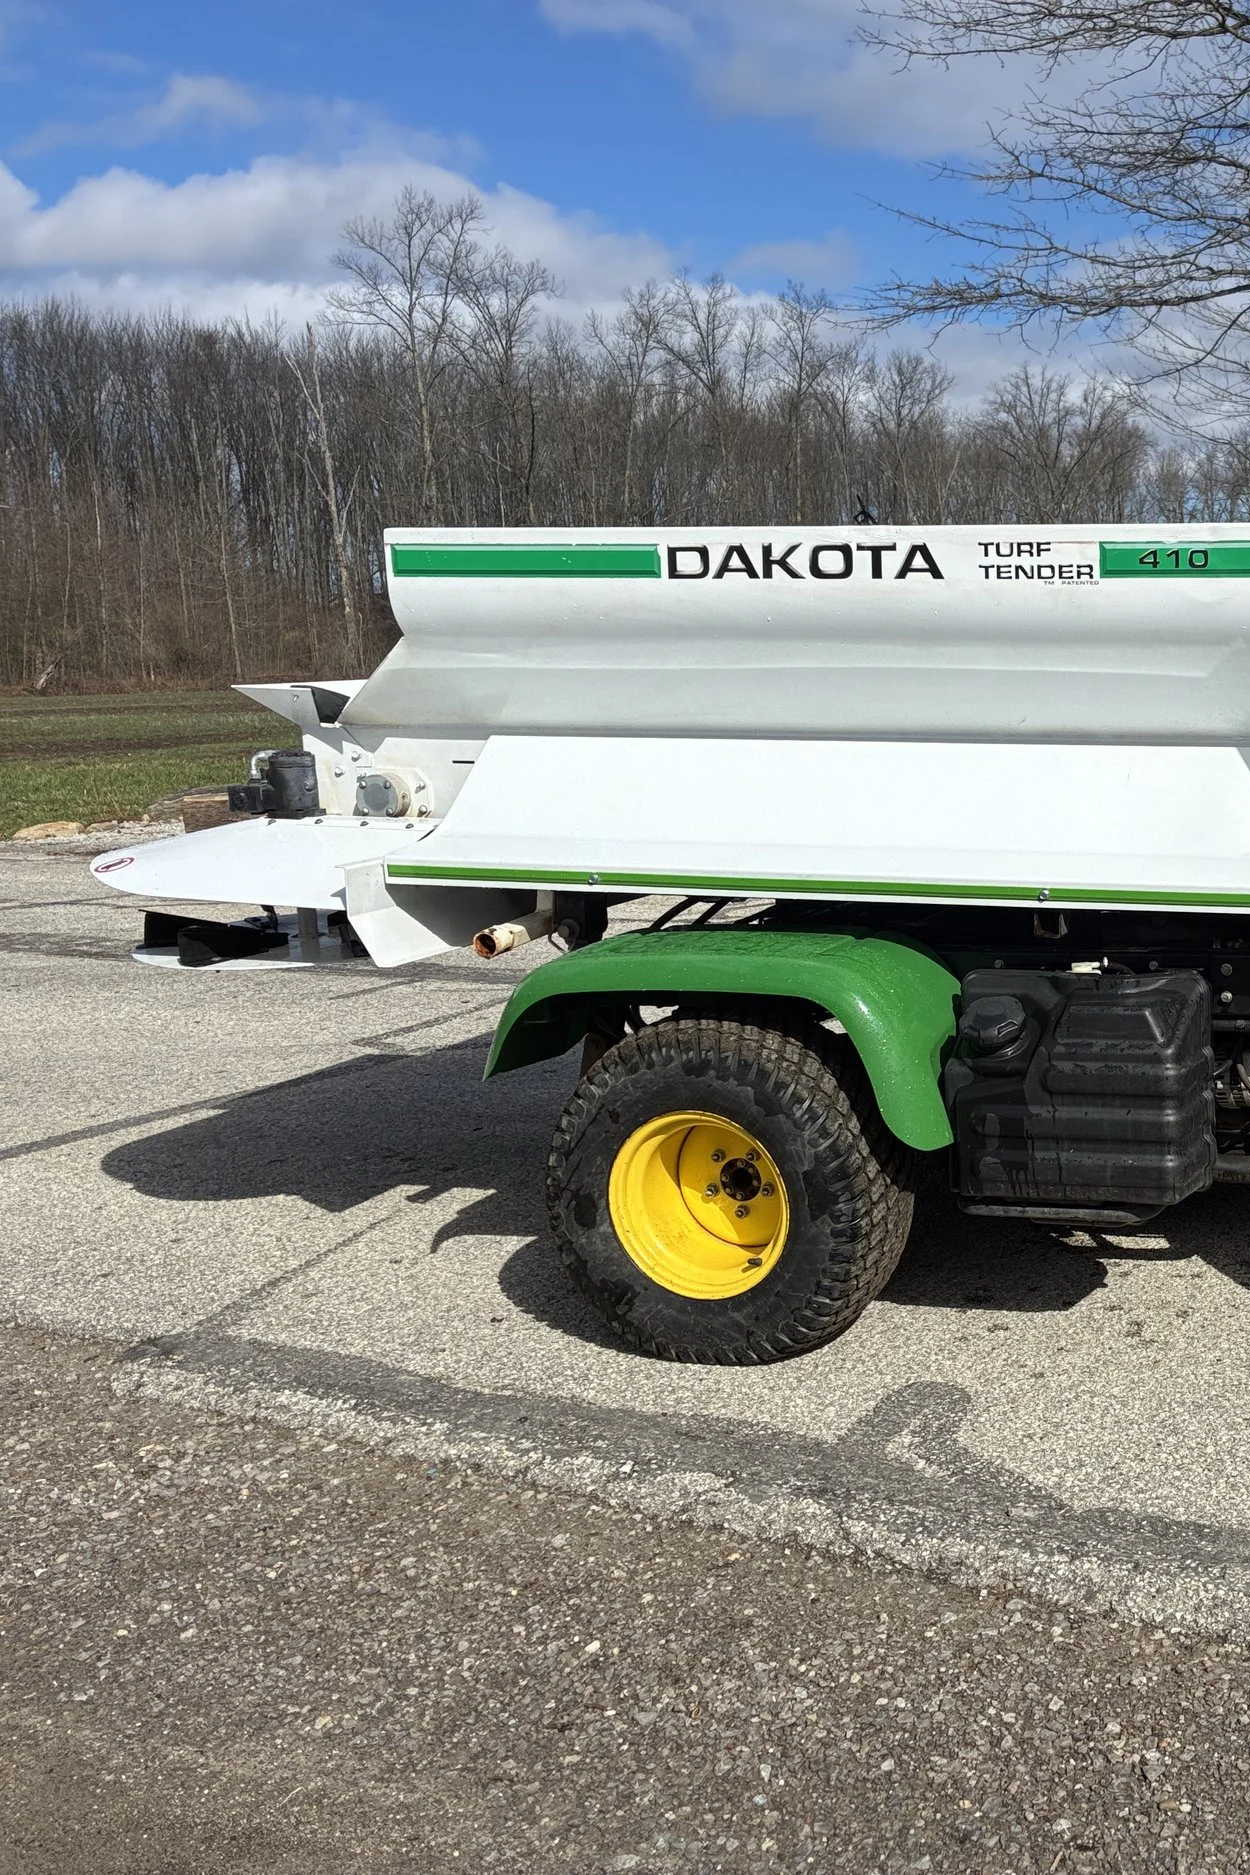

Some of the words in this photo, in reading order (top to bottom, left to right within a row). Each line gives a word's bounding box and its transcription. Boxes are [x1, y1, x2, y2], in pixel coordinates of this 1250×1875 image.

[977, 541, 1052, 558] TURF
[1138, 548, 1210, 569] 410
[667, 542, 945, 580] DAKOTA
[978, 564, 1094, 580] TENDER
